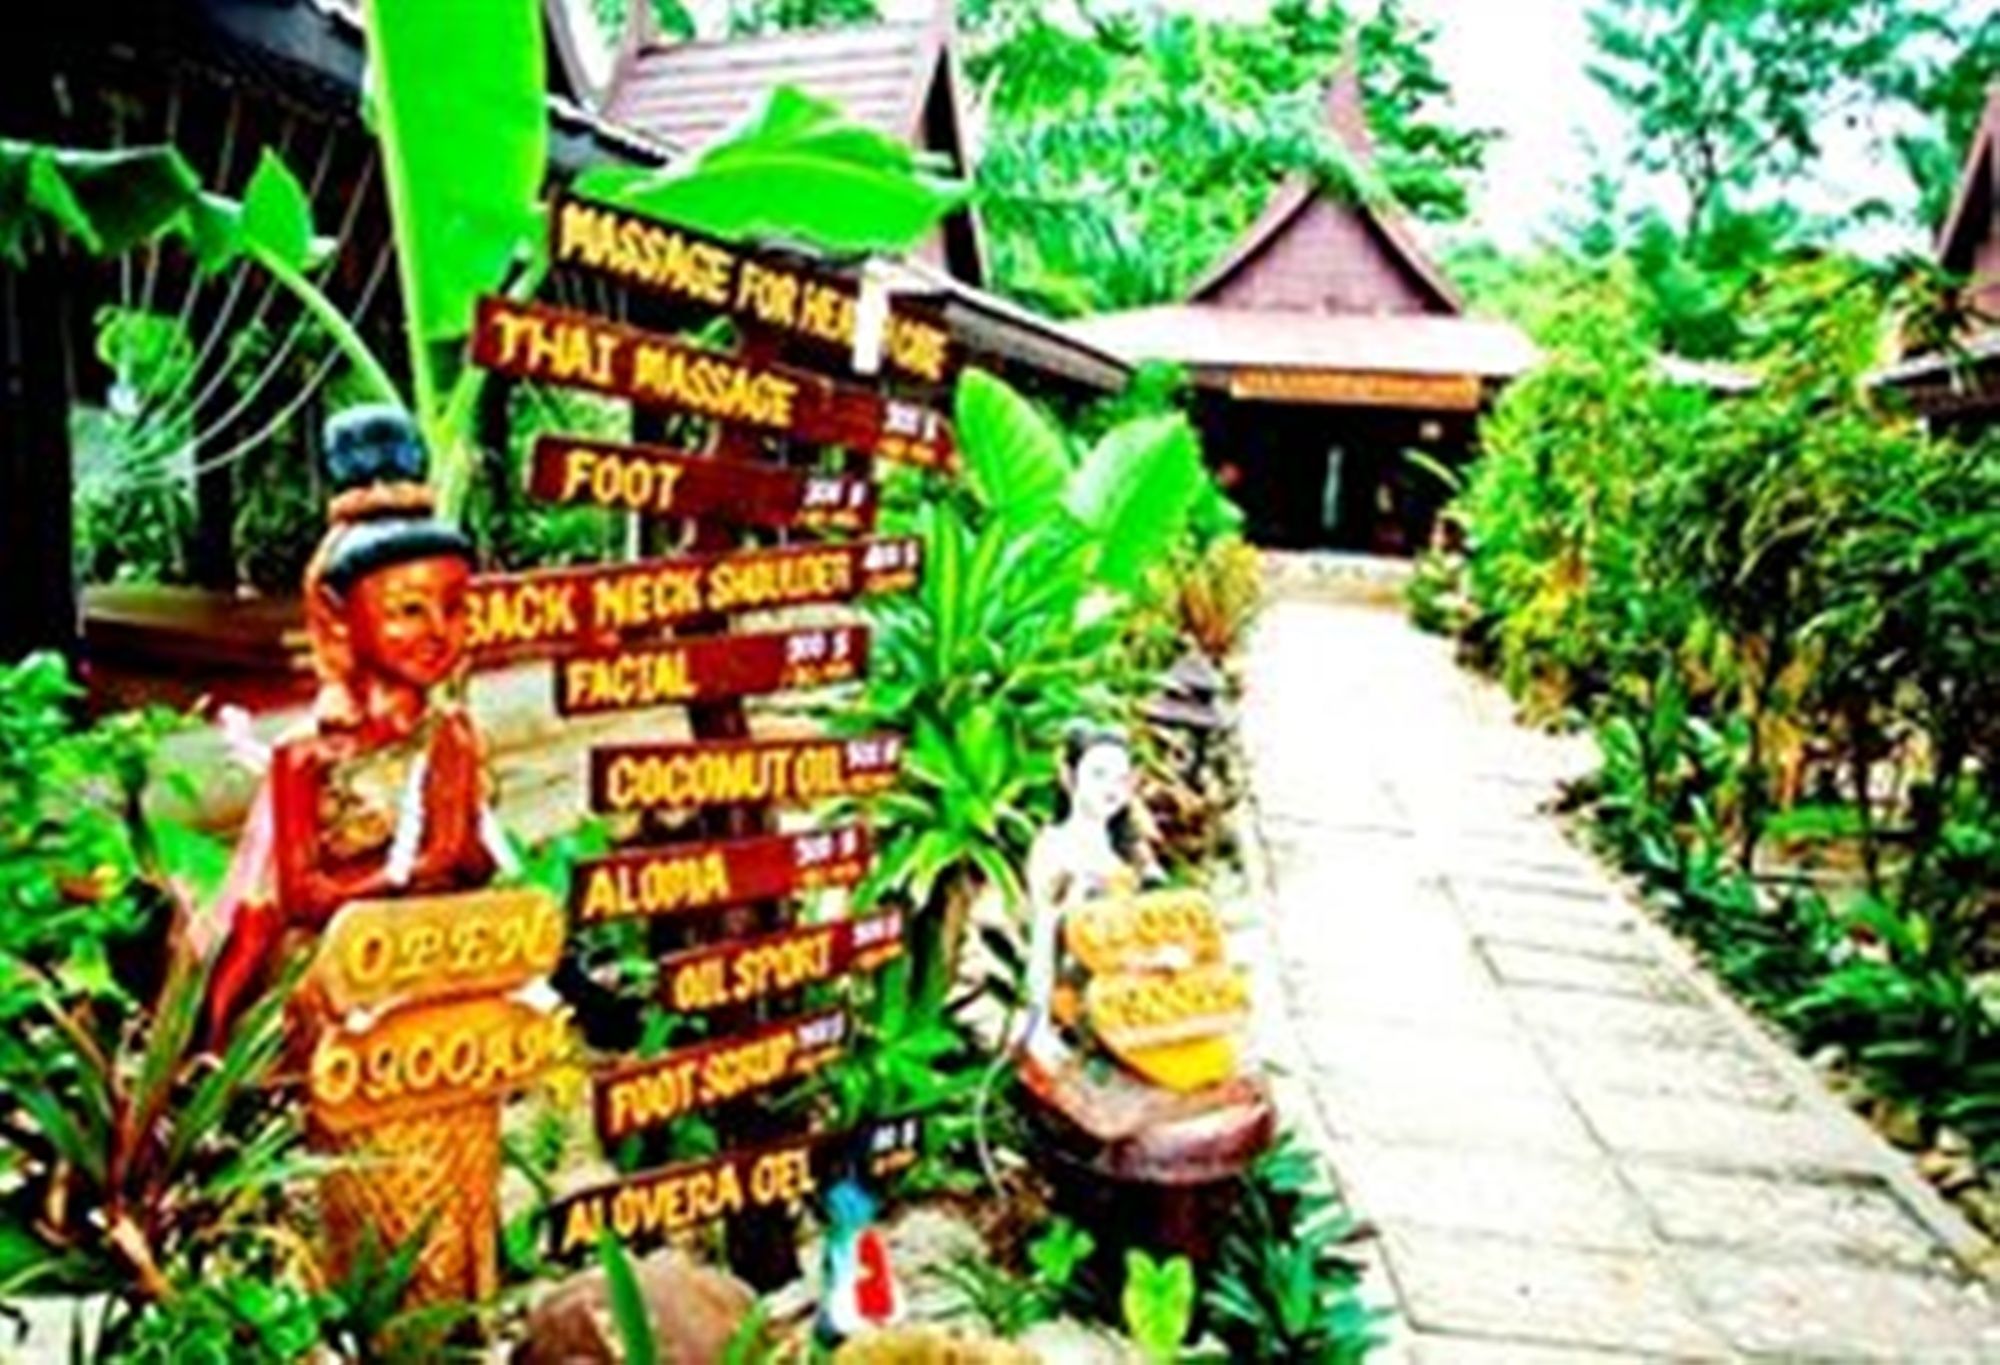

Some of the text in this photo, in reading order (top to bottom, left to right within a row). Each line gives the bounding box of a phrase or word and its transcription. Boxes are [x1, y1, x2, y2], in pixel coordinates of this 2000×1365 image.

[560, 203, 734, 304] MASSAGE
[737, 262, 797, 328] FOR
[492, 311, 621, 386] THAI
[632, 341, 798, 427] MASSAGE
[560, 450, 683, 510] FOOT
[464, 584, 577, 647] BACK
[592, 567, 702, 627] NECK
[566, 649, 698, 707] FACIAL
[607, 749, 794, 808] COCONUT
[796, 746, 845, 799] OIL
[349, 903, 560, 983] OPEN
[675, 931, 834, 1010] OIL SPORT
[608, 1060, 699, 1135] FOOT
